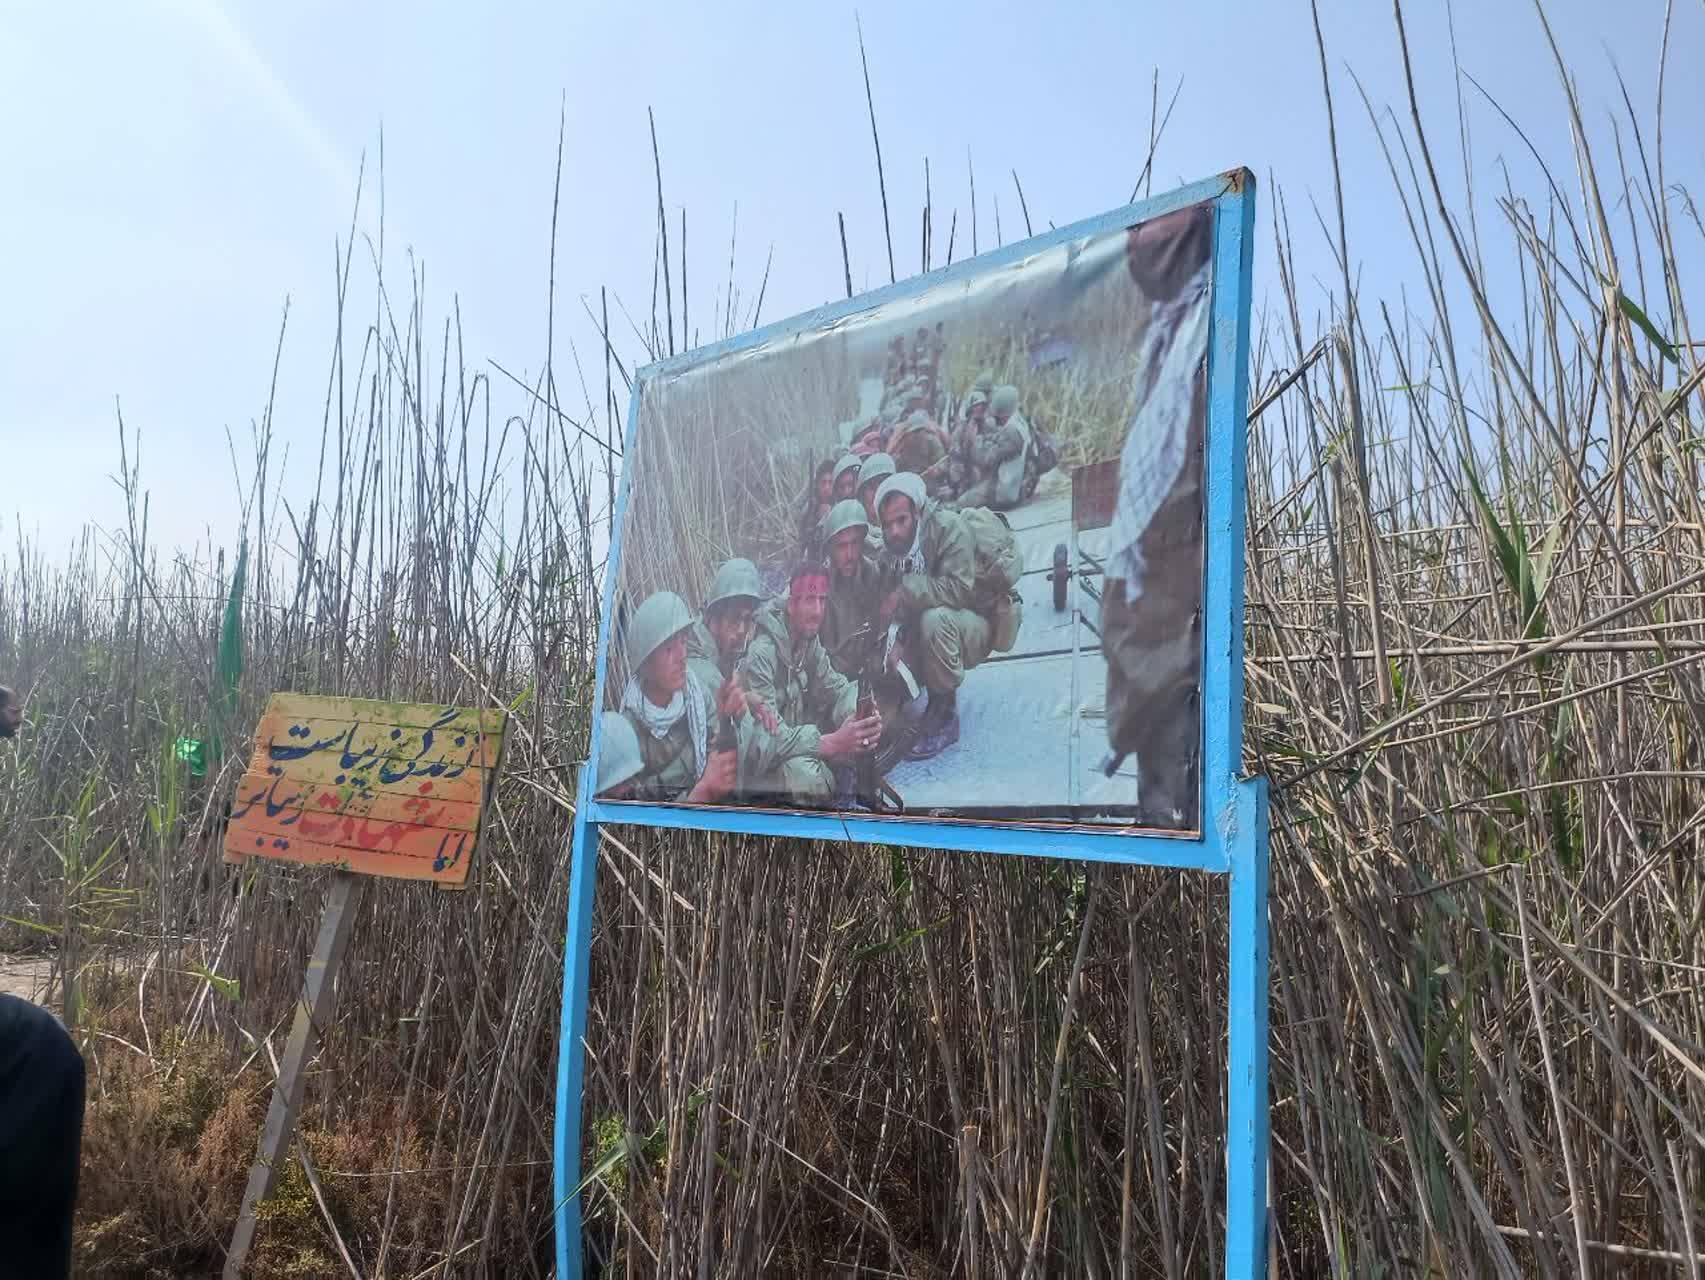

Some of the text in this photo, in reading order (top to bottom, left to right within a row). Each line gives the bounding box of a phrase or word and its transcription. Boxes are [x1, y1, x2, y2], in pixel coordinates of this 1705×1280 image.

[269, 708, 487, 786] زندگی زیباست
[231, 766, 468, 872] اما شهادت زیباتر
